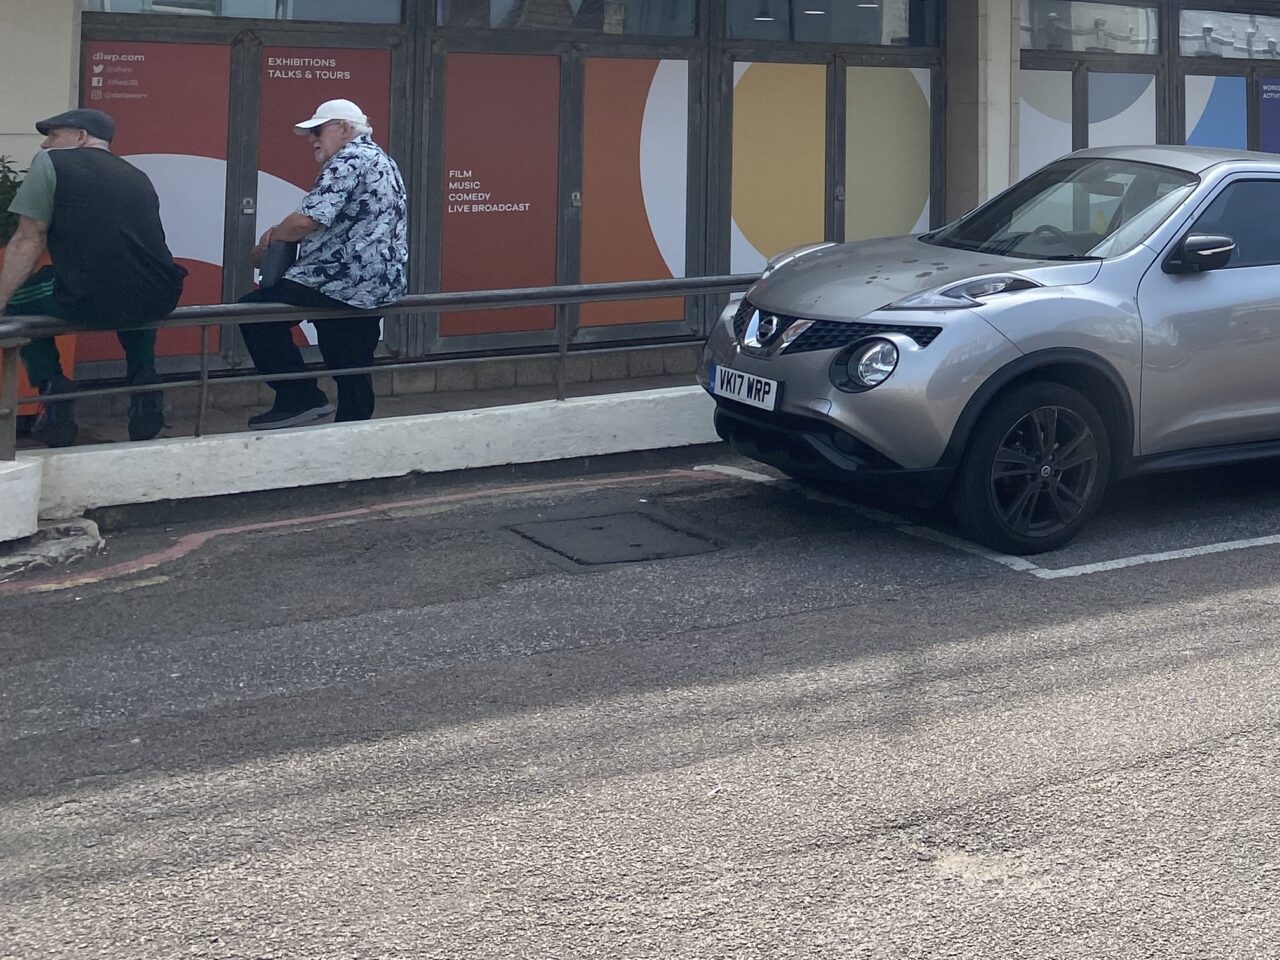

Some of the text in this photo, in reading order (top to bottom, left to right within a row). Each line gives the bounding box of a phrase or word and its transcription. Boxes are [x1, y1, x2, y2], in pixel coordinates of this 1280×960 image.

[92, 51, 145, 62] dlwp.com
[267, 57, 337, 67] EXHIBITIONS
[268, 69, 351, 80] TALKS & TOURS
[449, 170, 472, 178] FILM
[449, 181, 480, 189] MUSIC
[448, 193, 491, 201] COMEDY
[448, 203, 530, 213] LIVE BROADCAST
[720, 369, 771, 403] VK17 WRP
